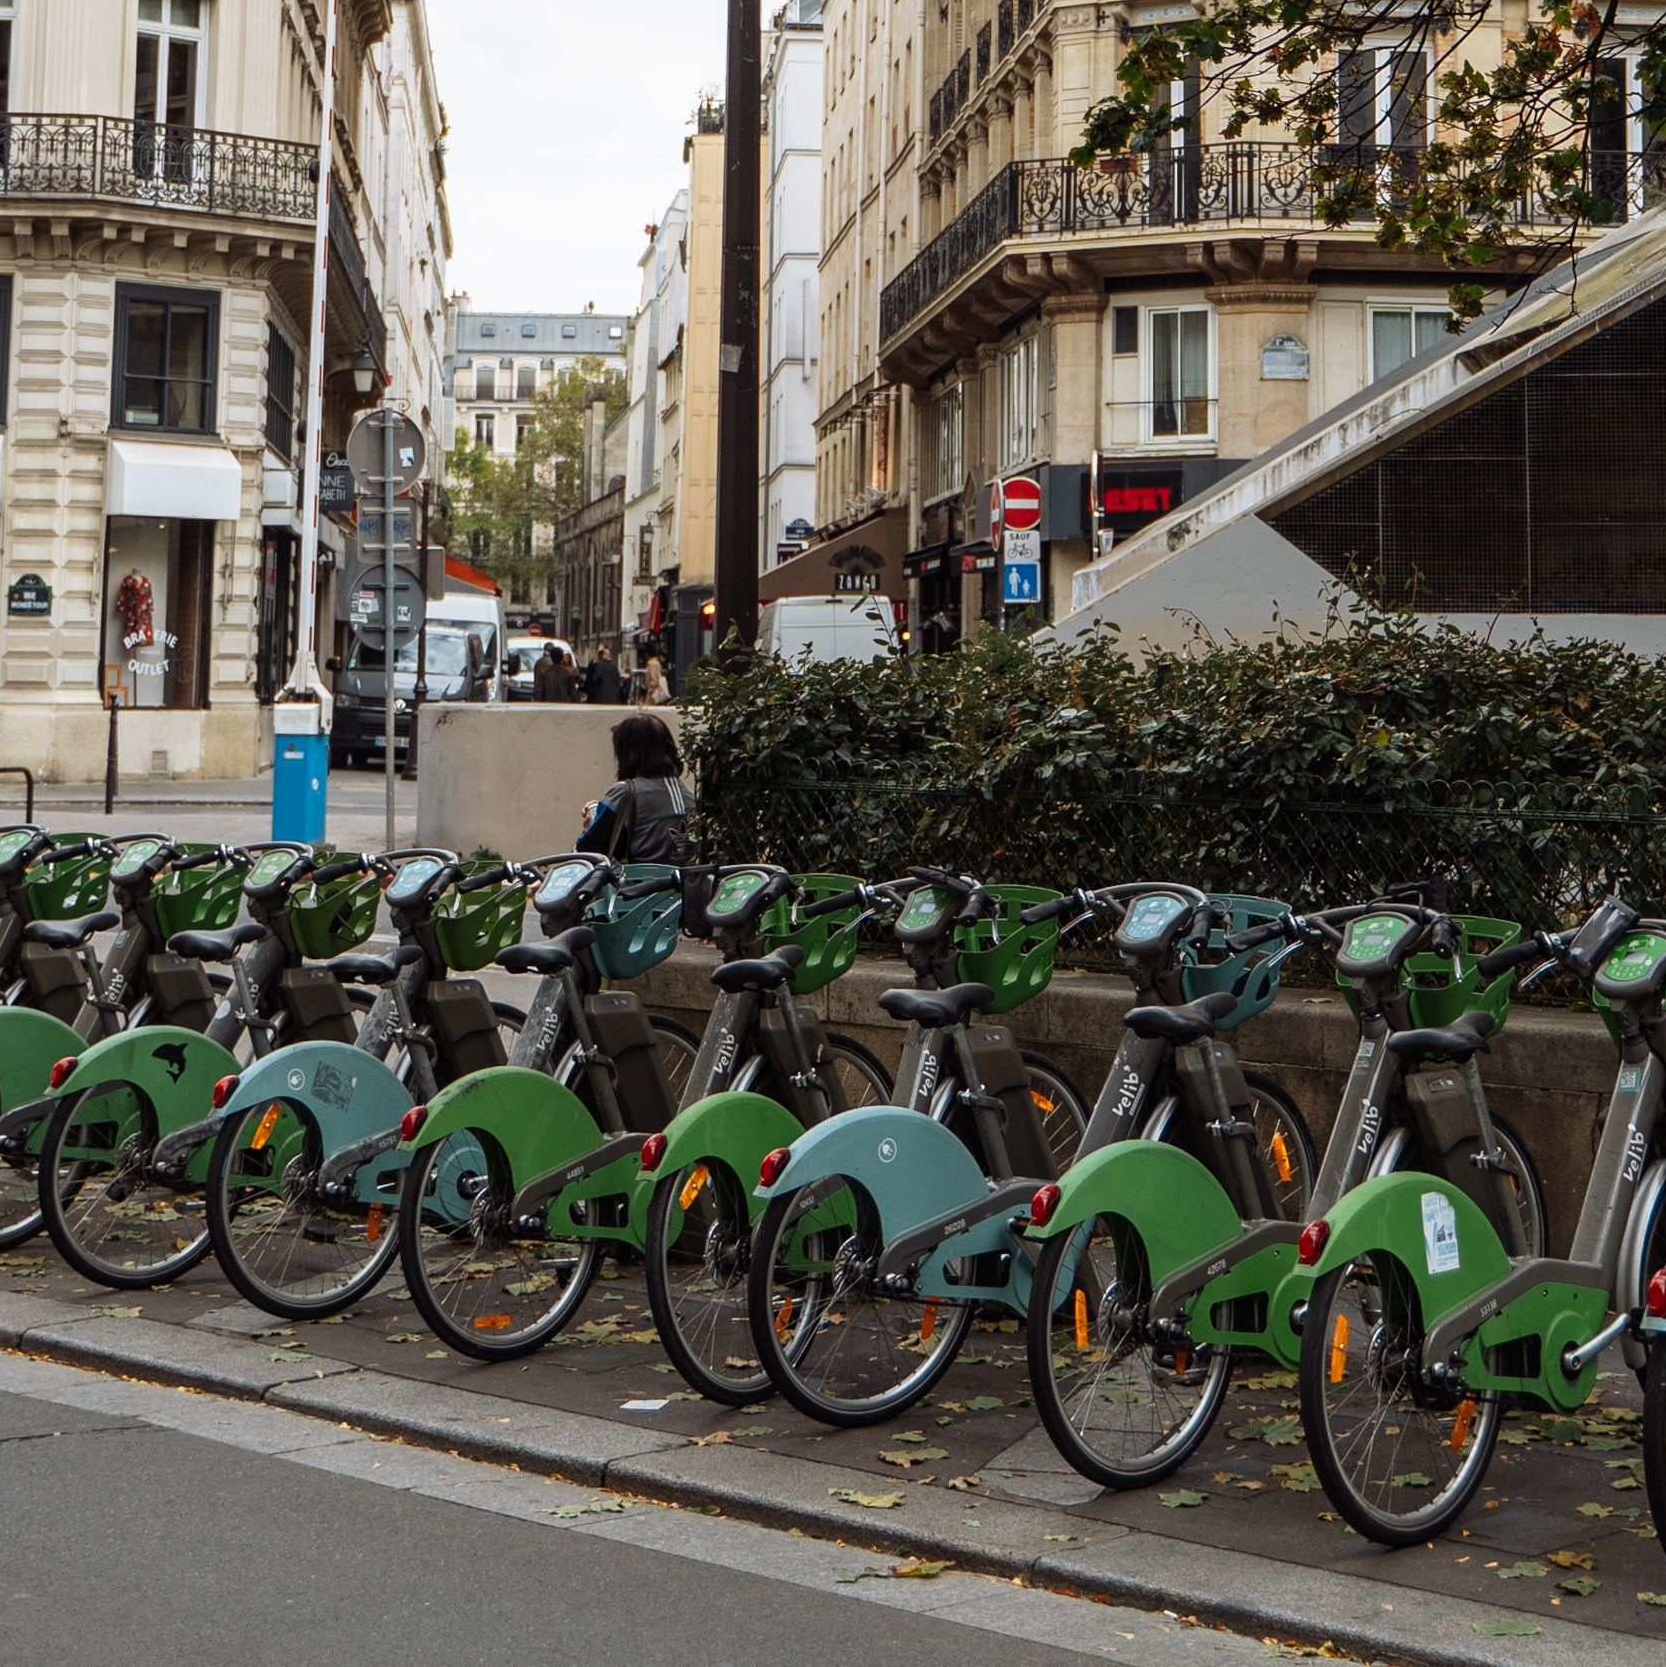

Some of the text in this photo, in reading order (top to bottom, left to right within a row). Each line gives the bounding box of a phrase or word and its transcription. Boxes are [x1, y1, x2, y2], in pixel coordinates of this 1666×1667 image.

[320, 476, 346, 488] NNE
[1088, 487, 1172, 512] ESET
[839, 575, 876, 590] ZANO
[123, 629, 179, 650] BRAERIE
[128, 659, 170, 675] OUTLET
